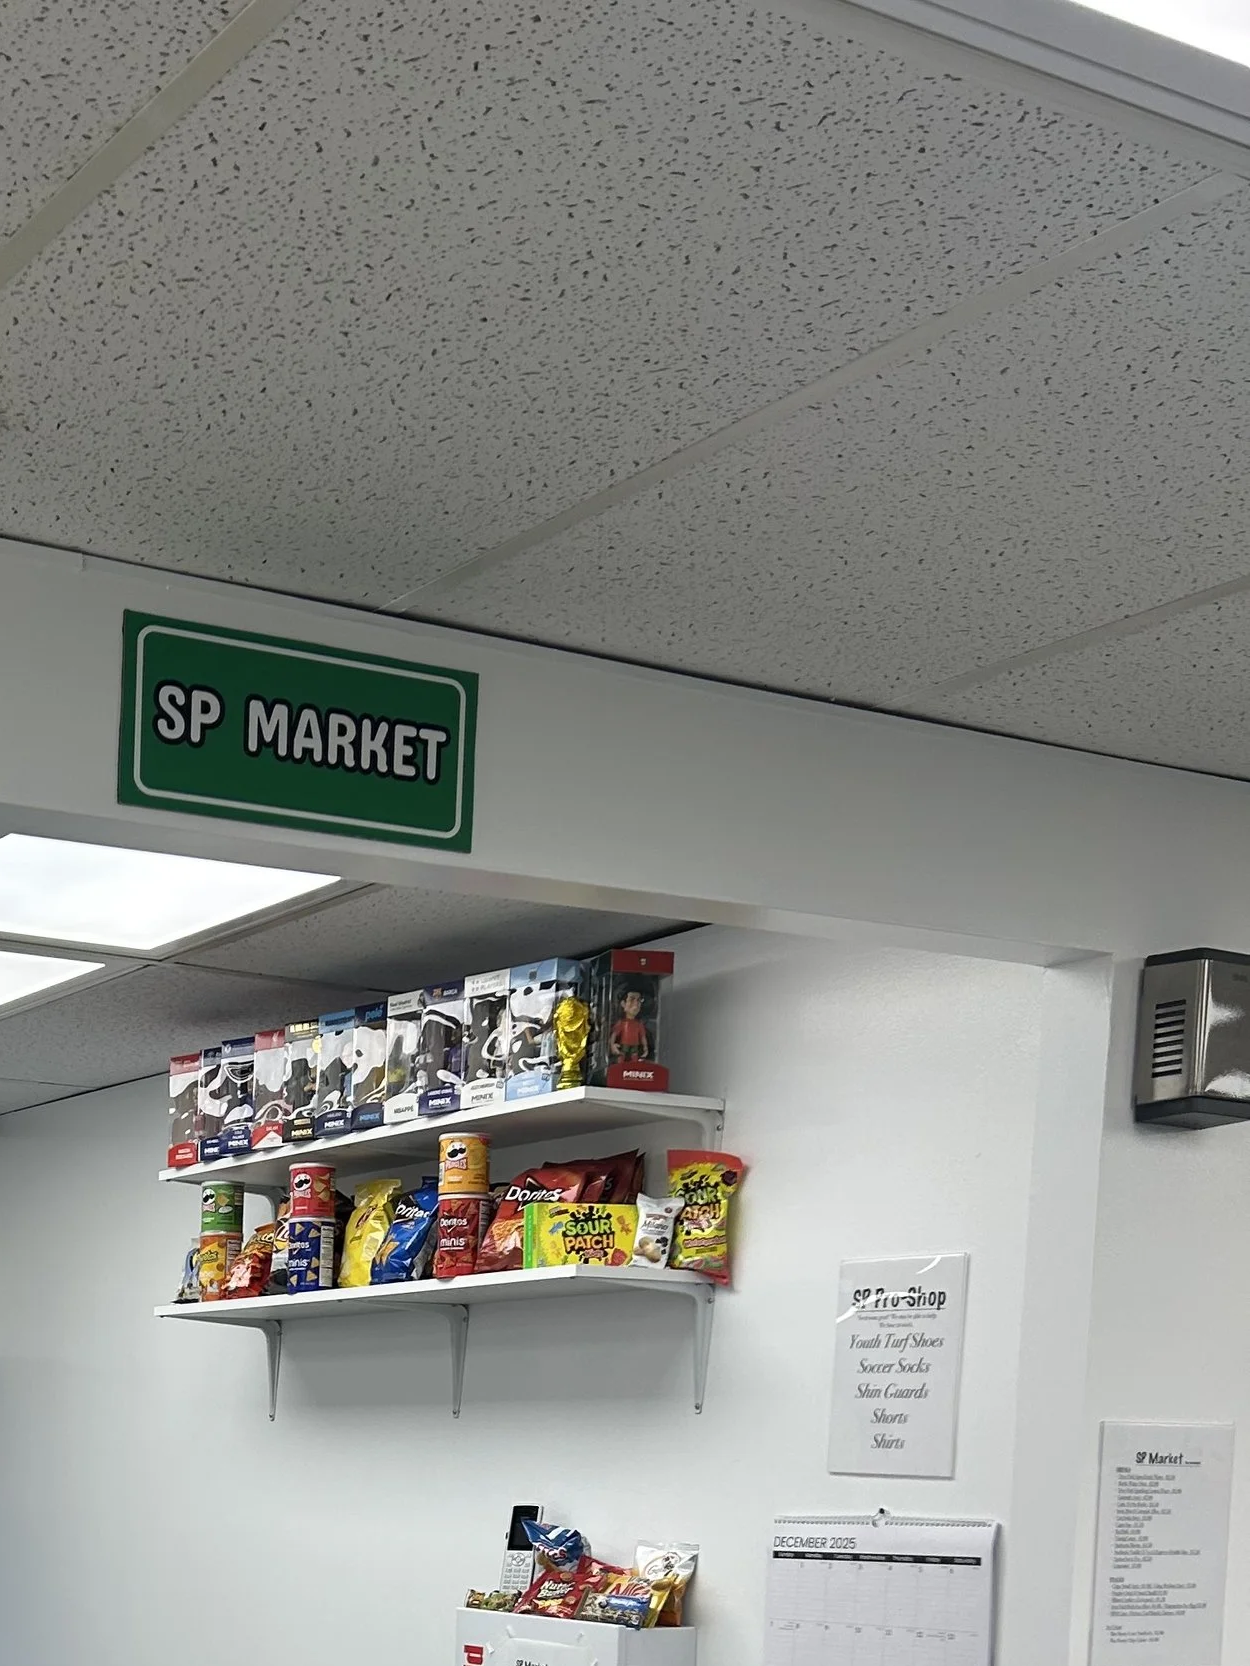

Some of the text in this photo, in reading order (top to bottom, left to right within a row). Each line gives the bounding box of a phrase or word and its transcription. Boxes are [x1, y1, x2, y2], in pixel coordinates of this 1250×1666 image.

[156, 684, 448, 780] SP MARKET
[505, 1186, 562, 1201] Doritos
[681, 1202, 720, 1219] ATCH
[565, 1219, 611, 1235] SOUR
[440, 1237, 466, 1247] minis
[565, 1234, 614, 1251] PATCH
[850, 1332, 945, 1354] Youth Turf Shoes
[857, 1357, 932, 1374] Soccer Socks
[855, 1383, 929, 1400] Shin Guards
[871, 1408, 909, 1424] Shorts
[871, 1433, 905, 1450] Shirts
[1135, 1452, 1184, 1465] SP Market
[773, 1536, 857, 1549] DECEMBER 2025
